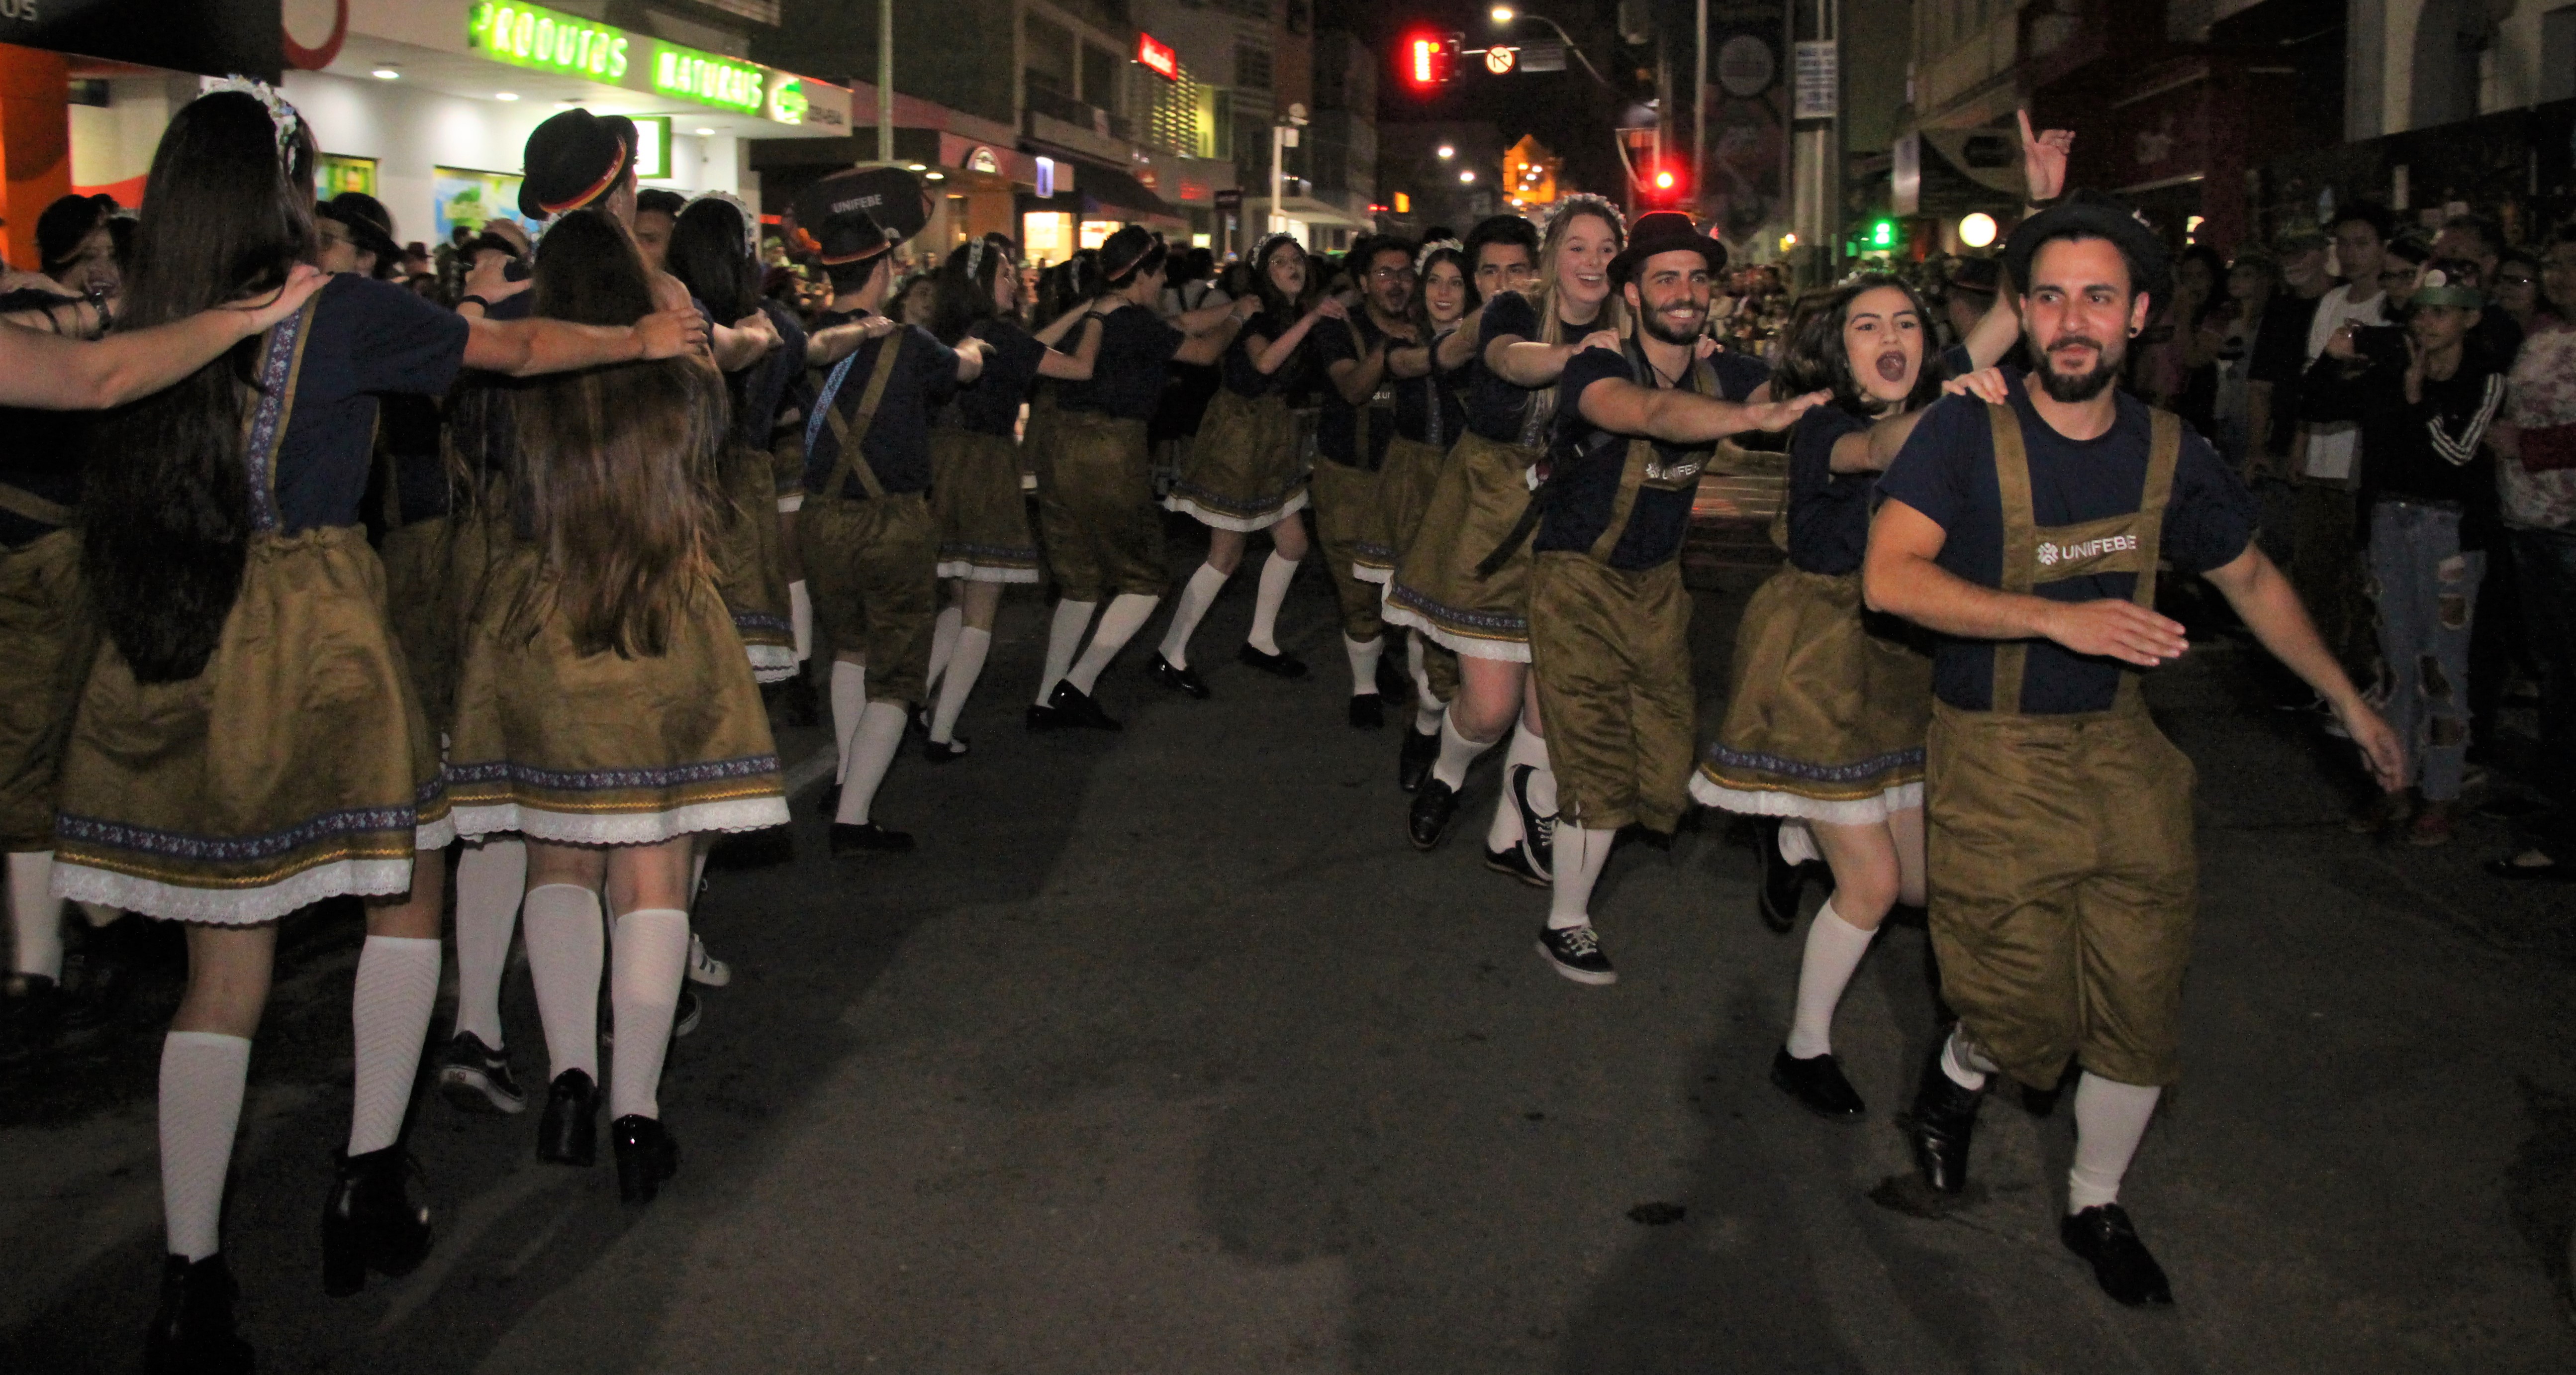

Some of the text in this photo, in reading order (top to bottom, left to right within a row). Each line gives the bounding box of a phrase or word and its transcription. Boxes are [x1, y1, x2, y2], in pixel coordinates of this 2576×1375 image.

[654, 52, 758, 108] NATURAIS
[831, 194, 882, 213] UNIFEBE
[2062, 535, 2137, 560] UNIFEBE
